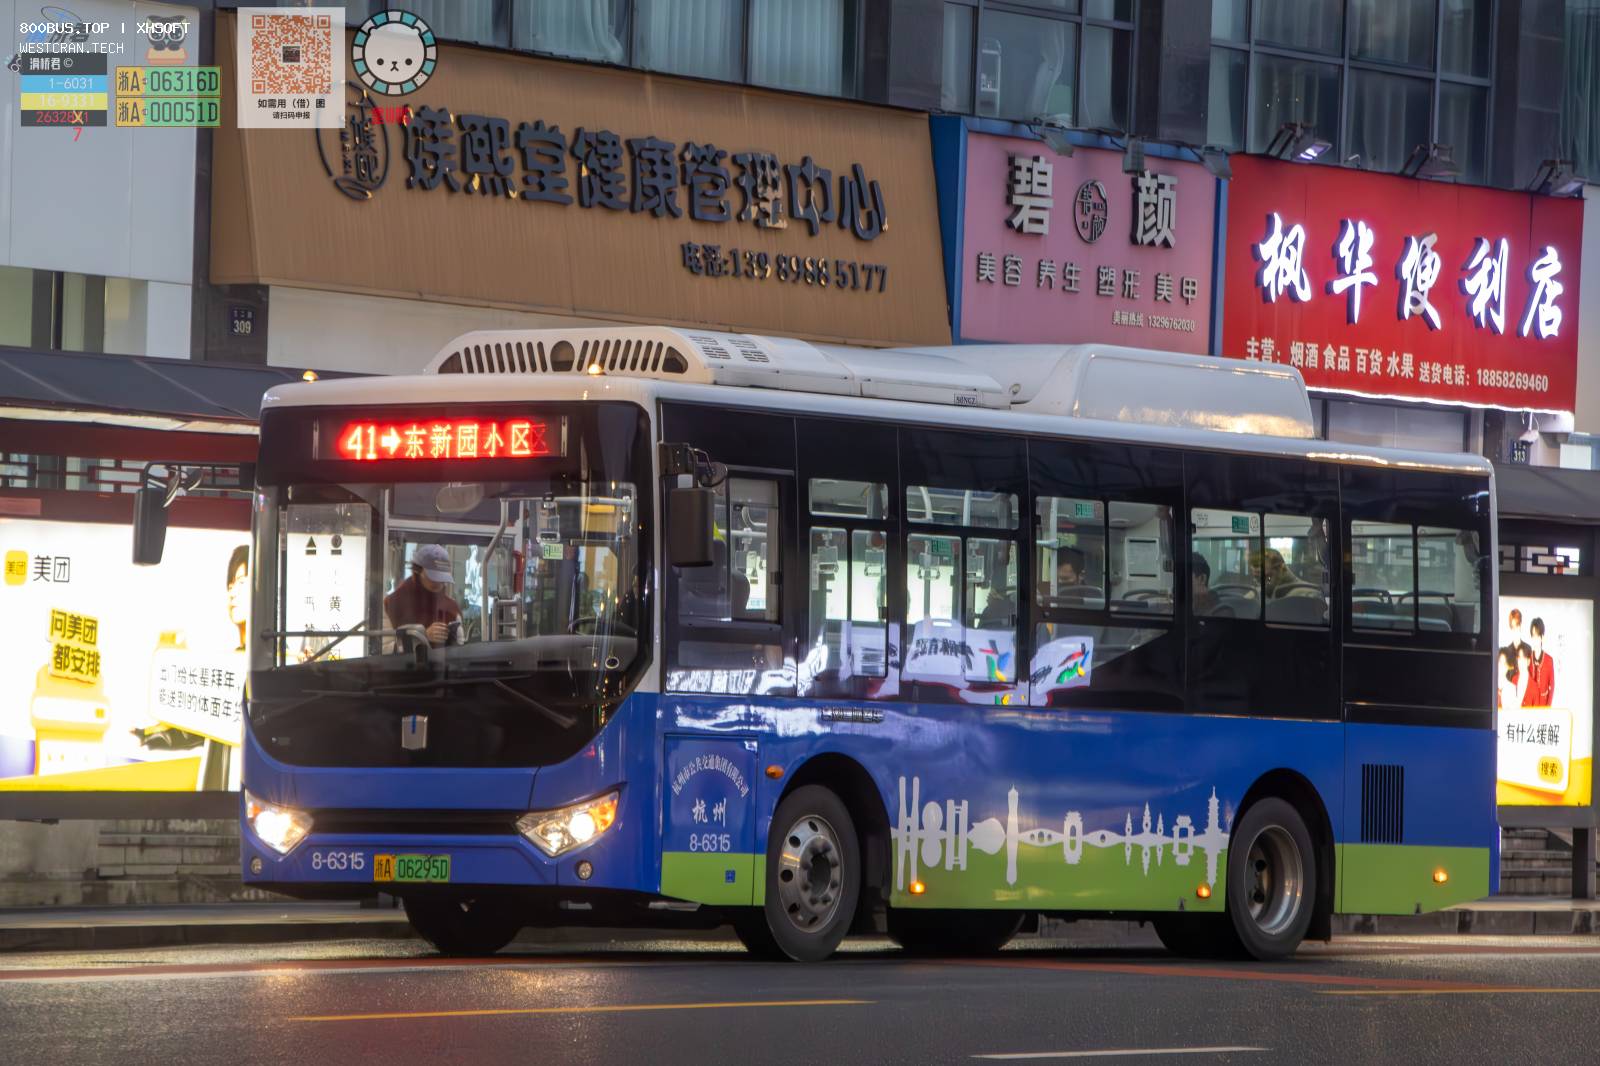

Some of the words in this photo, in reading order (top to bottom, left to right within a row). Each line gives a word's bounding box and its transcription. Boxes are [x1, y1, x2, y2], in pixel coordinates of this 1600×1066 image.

[1006, 152, 1053, 236] 碧
[1131, 168, 1179, 249] 颜
[977, 252, 1023, 286] 美容
[1038, 259, 1081, 293] 养生
[1097, 265, 1140, 299] 塑形
[1155, 273, 1198, 305] 美甲
[1252, 212, 1564, 339] 枫华便利店
[233, 320, 251, 334] 309
[1290, 340, 1319, 369] 烟酒
[1322, 345, 1350, 372] 食品
[1355, 348, 1383, 376] 百货
[1387, 351, 1414, 379] 水果
[1476, 368, 1549, 393] 18858269460
[347, 424, 377, 460] 41
[404, 422, 531, 458] 东新园小区
[1513, 450, 1526, 462] 313
[33, 554, 70, 583] 美团
[50, 608, 98, 645] 问美团
[53, 643, 100, 678] 都安排
[1506, 722, 1560, 747] 有什么缓解
[1541, 760, 1558, 777] 搜索
[692, 797, 727, 828] 杭州
[689, 833, 731, 852] 8-6315
[312, 852, 365, 870] 8-6315
